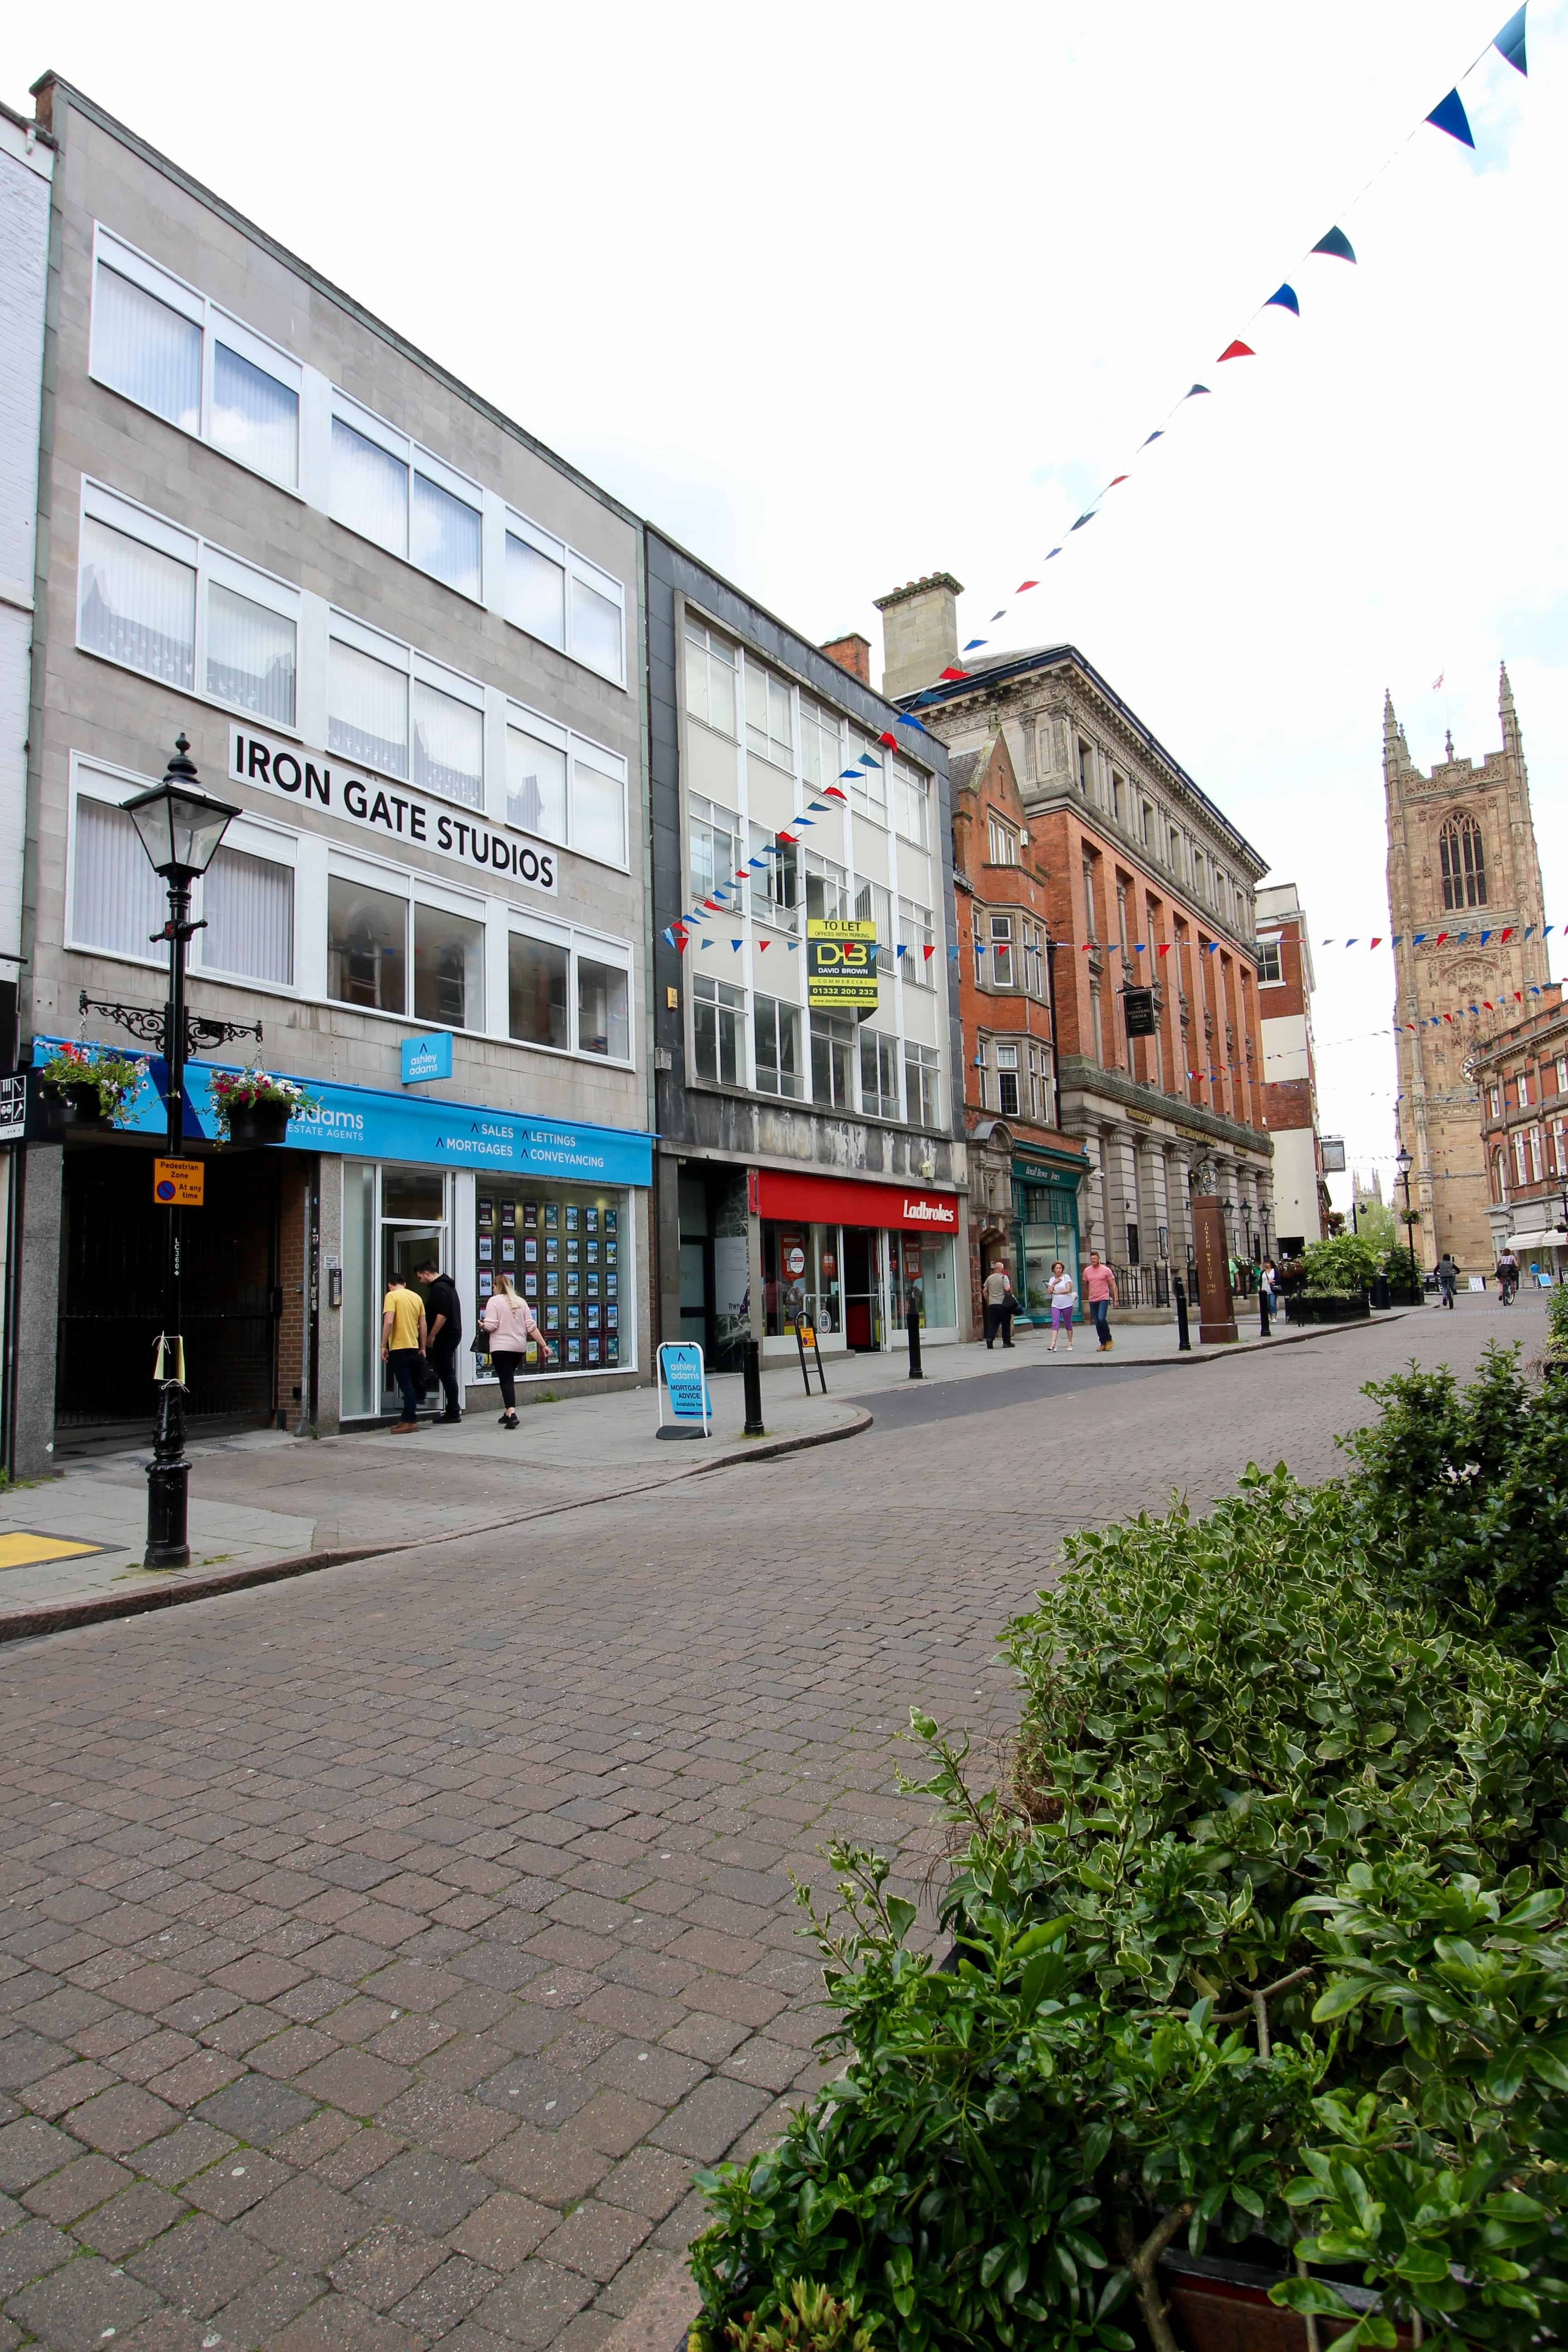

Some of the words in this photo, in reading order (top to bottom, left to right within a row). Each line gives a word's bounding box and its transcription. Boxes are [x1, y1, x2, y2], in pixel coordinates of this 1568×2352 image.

[237, 735, 330, 806] IRON
[343, 780, 426, 842] GATE
[437, 816, 553, 887] STUDIOS
[823, 921, 838, 931] TO
[842, 922, 861, 931] LET
[411, 1054, 437, 1065] ashley
[410, 1064, 438, 1075] adams
[288, 1124, 323, 1136] ESTATE
[327, 1129, 363, 1141] AGENTS
[481, 1123, 514, 1138] SALES
[531, 1131, 576, 1147] LETTINGS
[446, 1138, 513, 1156] MORTGAGES
[530, 1149, 604, 1168] CONVEYANCING
[161, 1161, 199, 1171] Pedestrian
[903, 1199, 954, 1222] Ladbrokes
[670, 1362, 696, 1372] ashley
[671, 1372, 700, 1380] adams
